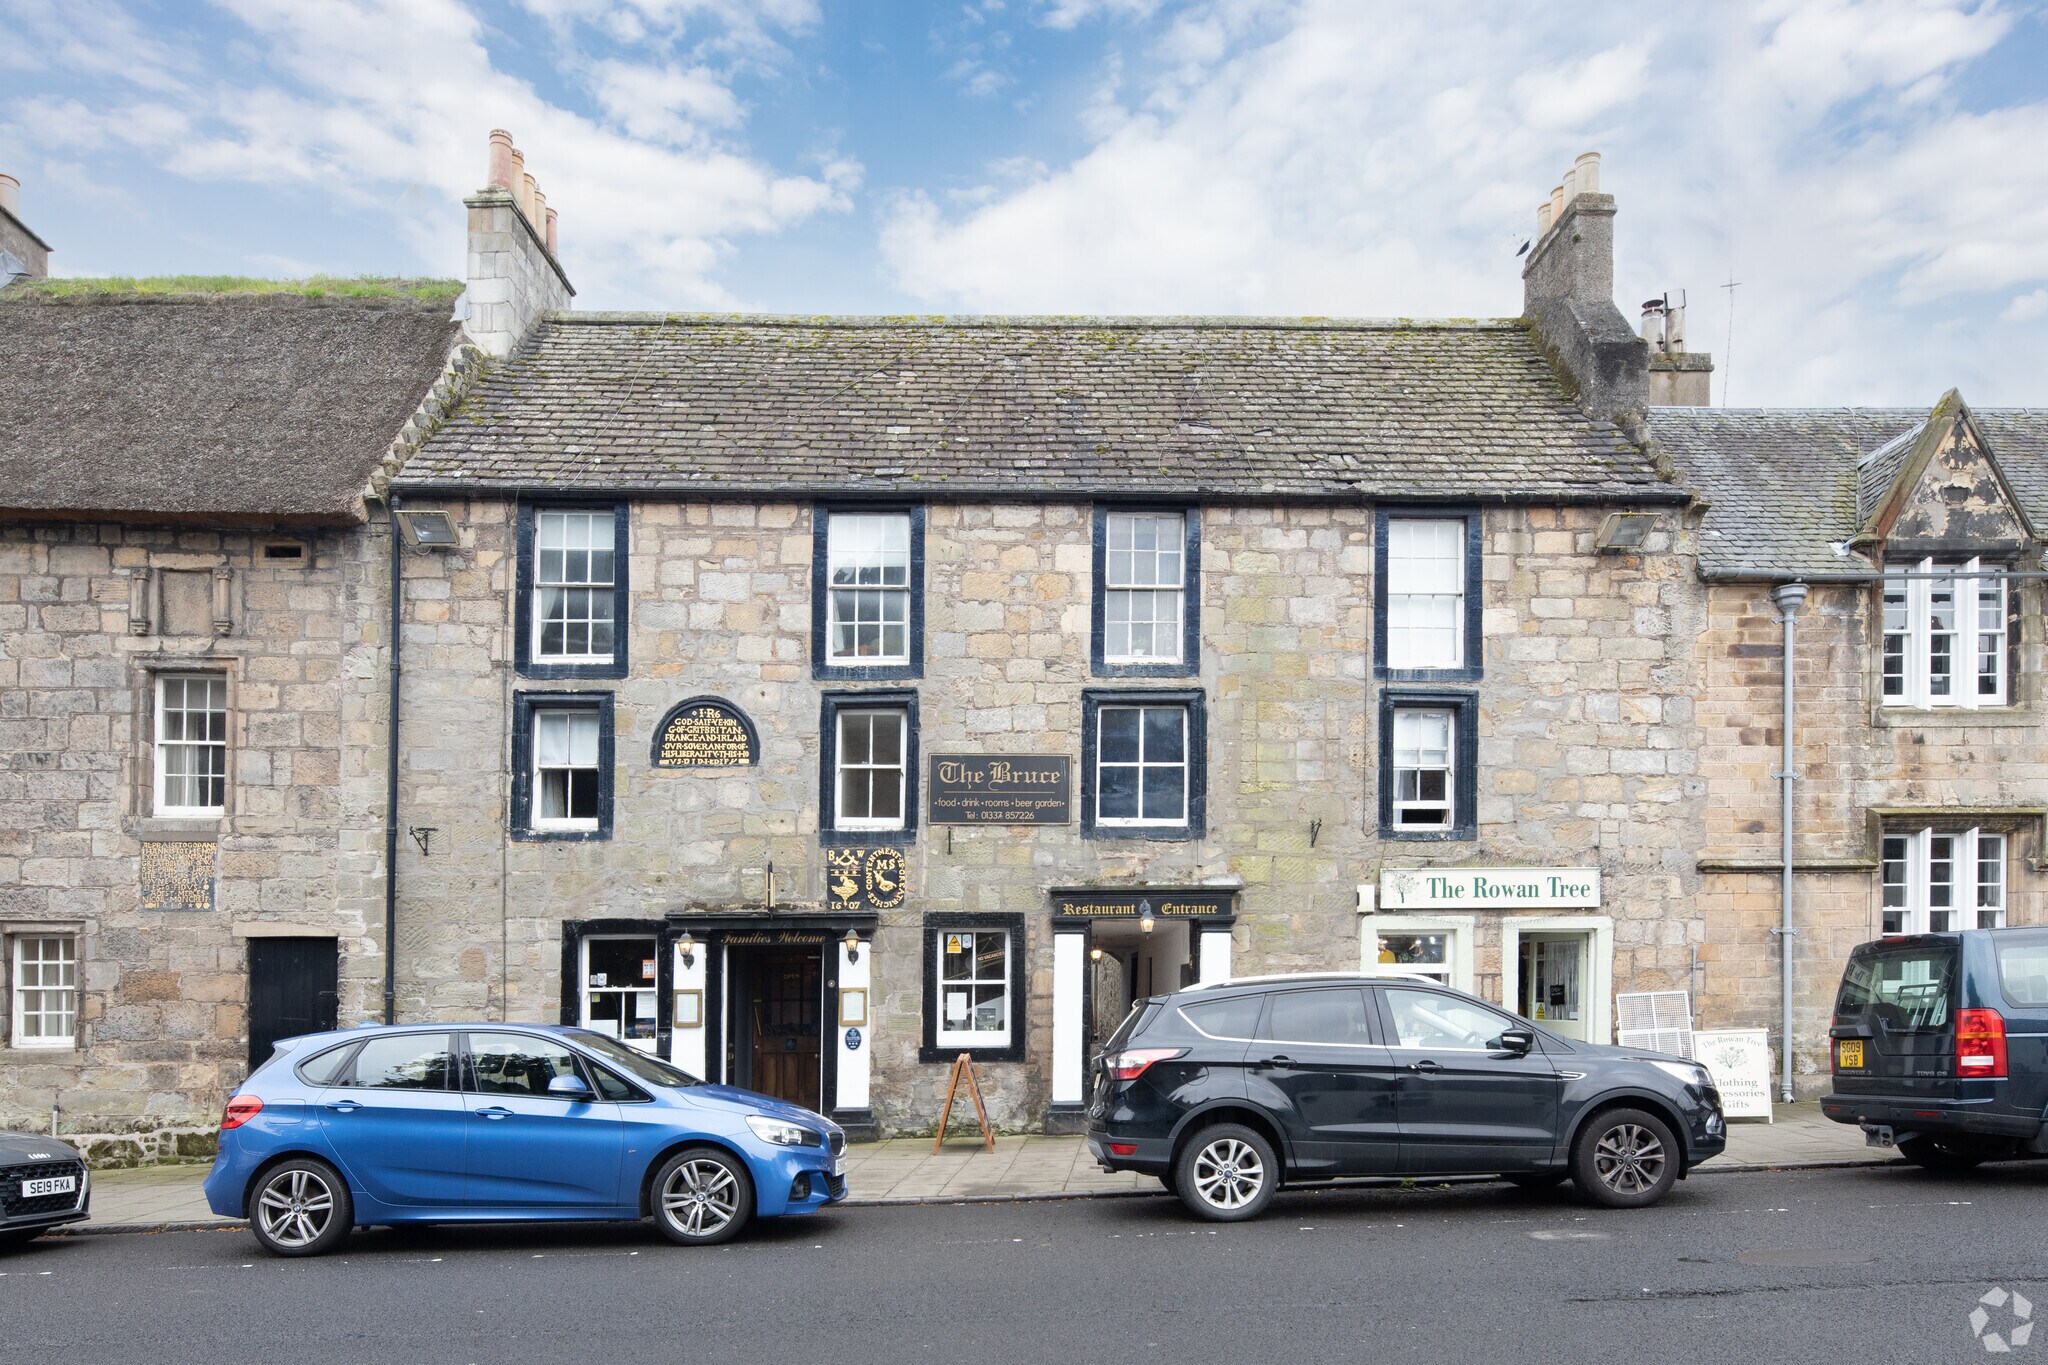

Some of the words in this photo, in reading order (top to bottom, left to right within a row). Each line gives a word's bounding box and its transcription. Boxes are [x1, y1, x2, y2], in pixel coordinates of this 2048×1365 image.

[938, 761, 984, 789] The
[988, 761, 1060, 790] Bruce
[938, 798, 957, 807] food
[961, 798, 980, 807] drink
[1015, 798, 1033, 807] beer
[1034, 799, 1062, 809] garden
[981, 811, 1002, 819] 01337
[1004, 811, 1035, 819] 857226
[828, 850, 835, 860] B
[876, 859, 896, 870] MS
[1426, 877, 1465, 898] The
[1472, 877, 1540, 898] Rowan
[1547, 877, 1591, 897] Tree
[1063, 903, 1136, 915] Restaurant
[1161, 903, 1218, 914] Entrance
[721, 931, 771, 943] Families
[778, 931, 826, 943] Welcome
[1717, 1036, 1744, 1044] Rowan
[1746, 1037, 1763, 1047] Tree
[1841, 1042, 1861, 1053] SG09
[1844, 1055, 1859, 1066] YSB
[1715, 1079, 1758, 1088] lothing
[1720, 1089, 1766, 1097] essories
[1722, 1101, 1750, 1109] Gifts
[30, 1181, 52, 1194] SE19
[54, 1179, 71, 1191] FKA
